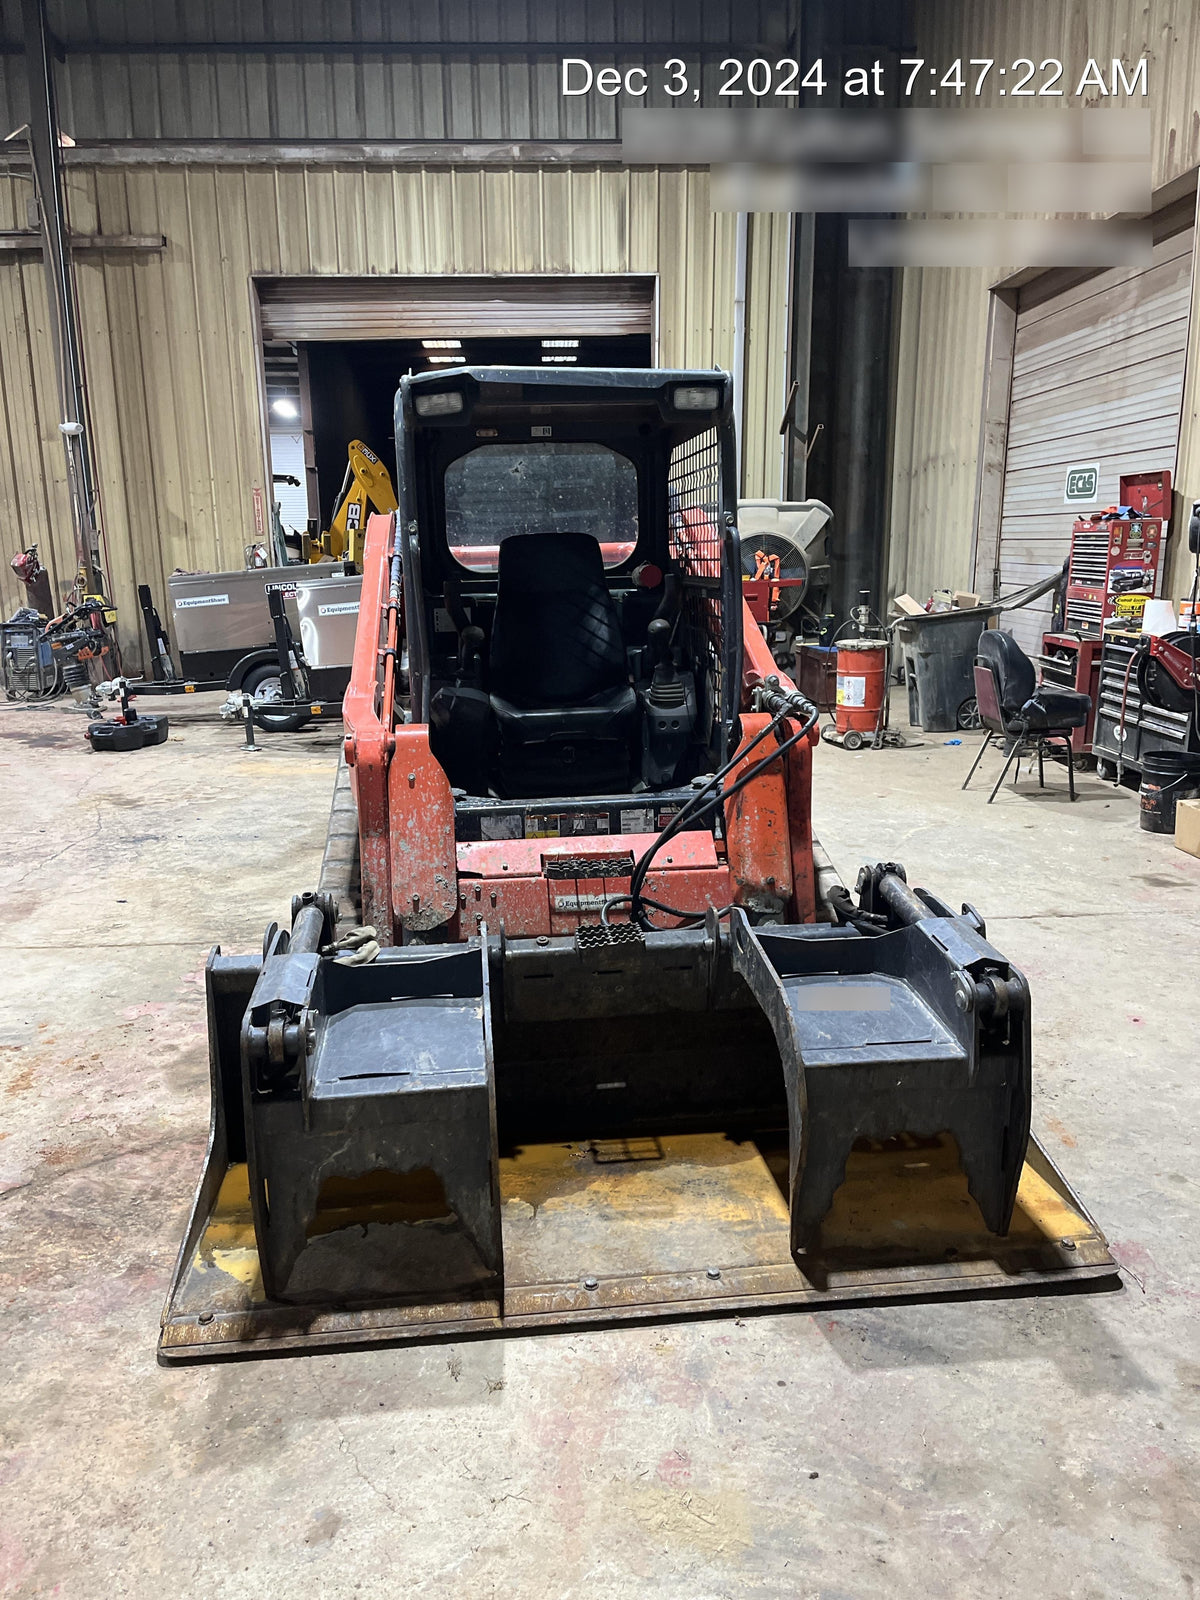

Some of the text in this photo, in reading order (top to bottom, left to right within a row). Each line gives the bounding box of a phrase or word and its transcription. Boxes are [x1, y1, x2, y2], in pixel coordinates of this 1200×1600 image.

[346, 503, 361, 531] CB
[266, 582, 297, 593] LINCOL
[183, 597, 226, 606] EquipmentShare
